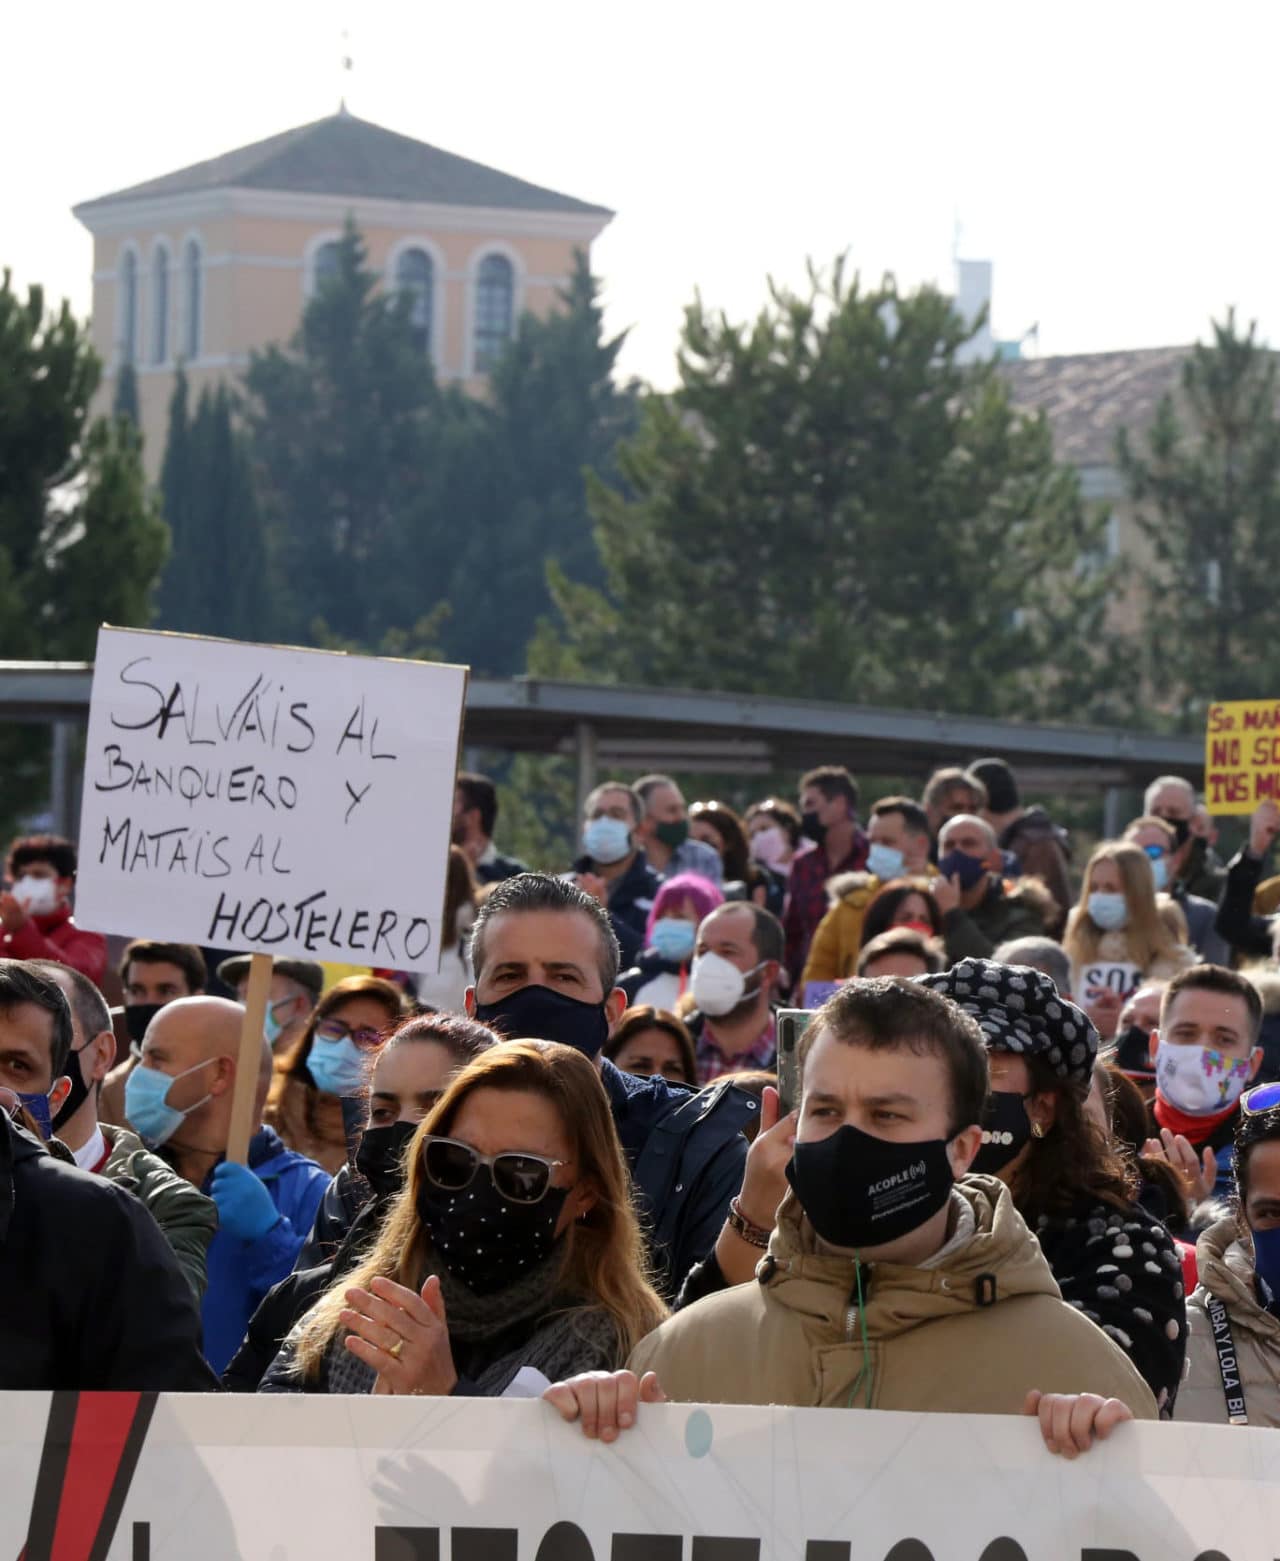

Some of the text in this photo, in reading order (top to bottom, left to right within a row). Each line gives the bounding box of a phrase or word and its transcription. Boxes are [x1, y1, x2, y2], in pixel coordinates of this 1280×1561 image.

[335, 693, 398, 761] AL
[1212, 738, 1241, 767] NO
[95, 744, 373, 825] BANQUERO Y
[1209, 773, 1249, 804] TUS
[244, 833, 292, 876] AL
[207, 890, 431, 961] HOSTELERO
[867, 1169, 909, 1197] ACOPLE
[1218, 1346, 1241, 1390] LOLA
